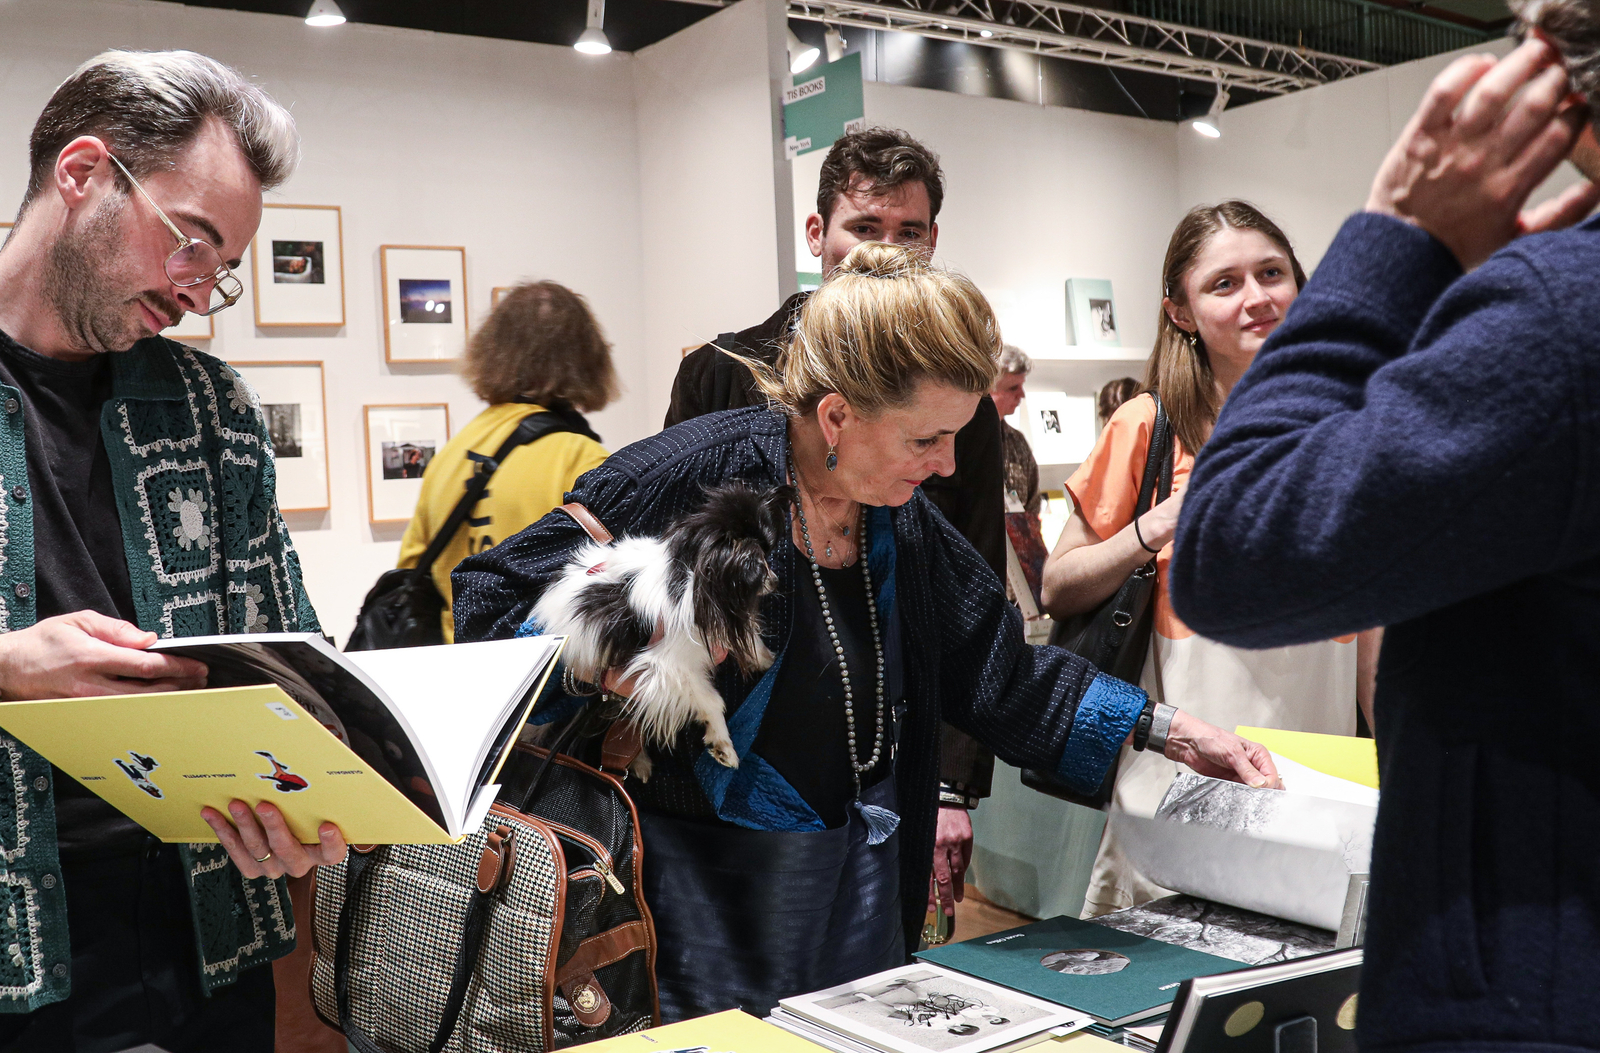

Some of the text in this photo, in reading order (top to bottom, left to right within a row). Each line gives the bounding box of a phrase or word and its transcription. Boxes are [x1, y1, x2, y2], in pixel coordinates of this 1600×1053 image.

[787, 80, 824, 101] TIS BOOKS
[789, 140, 810, 152] New York
